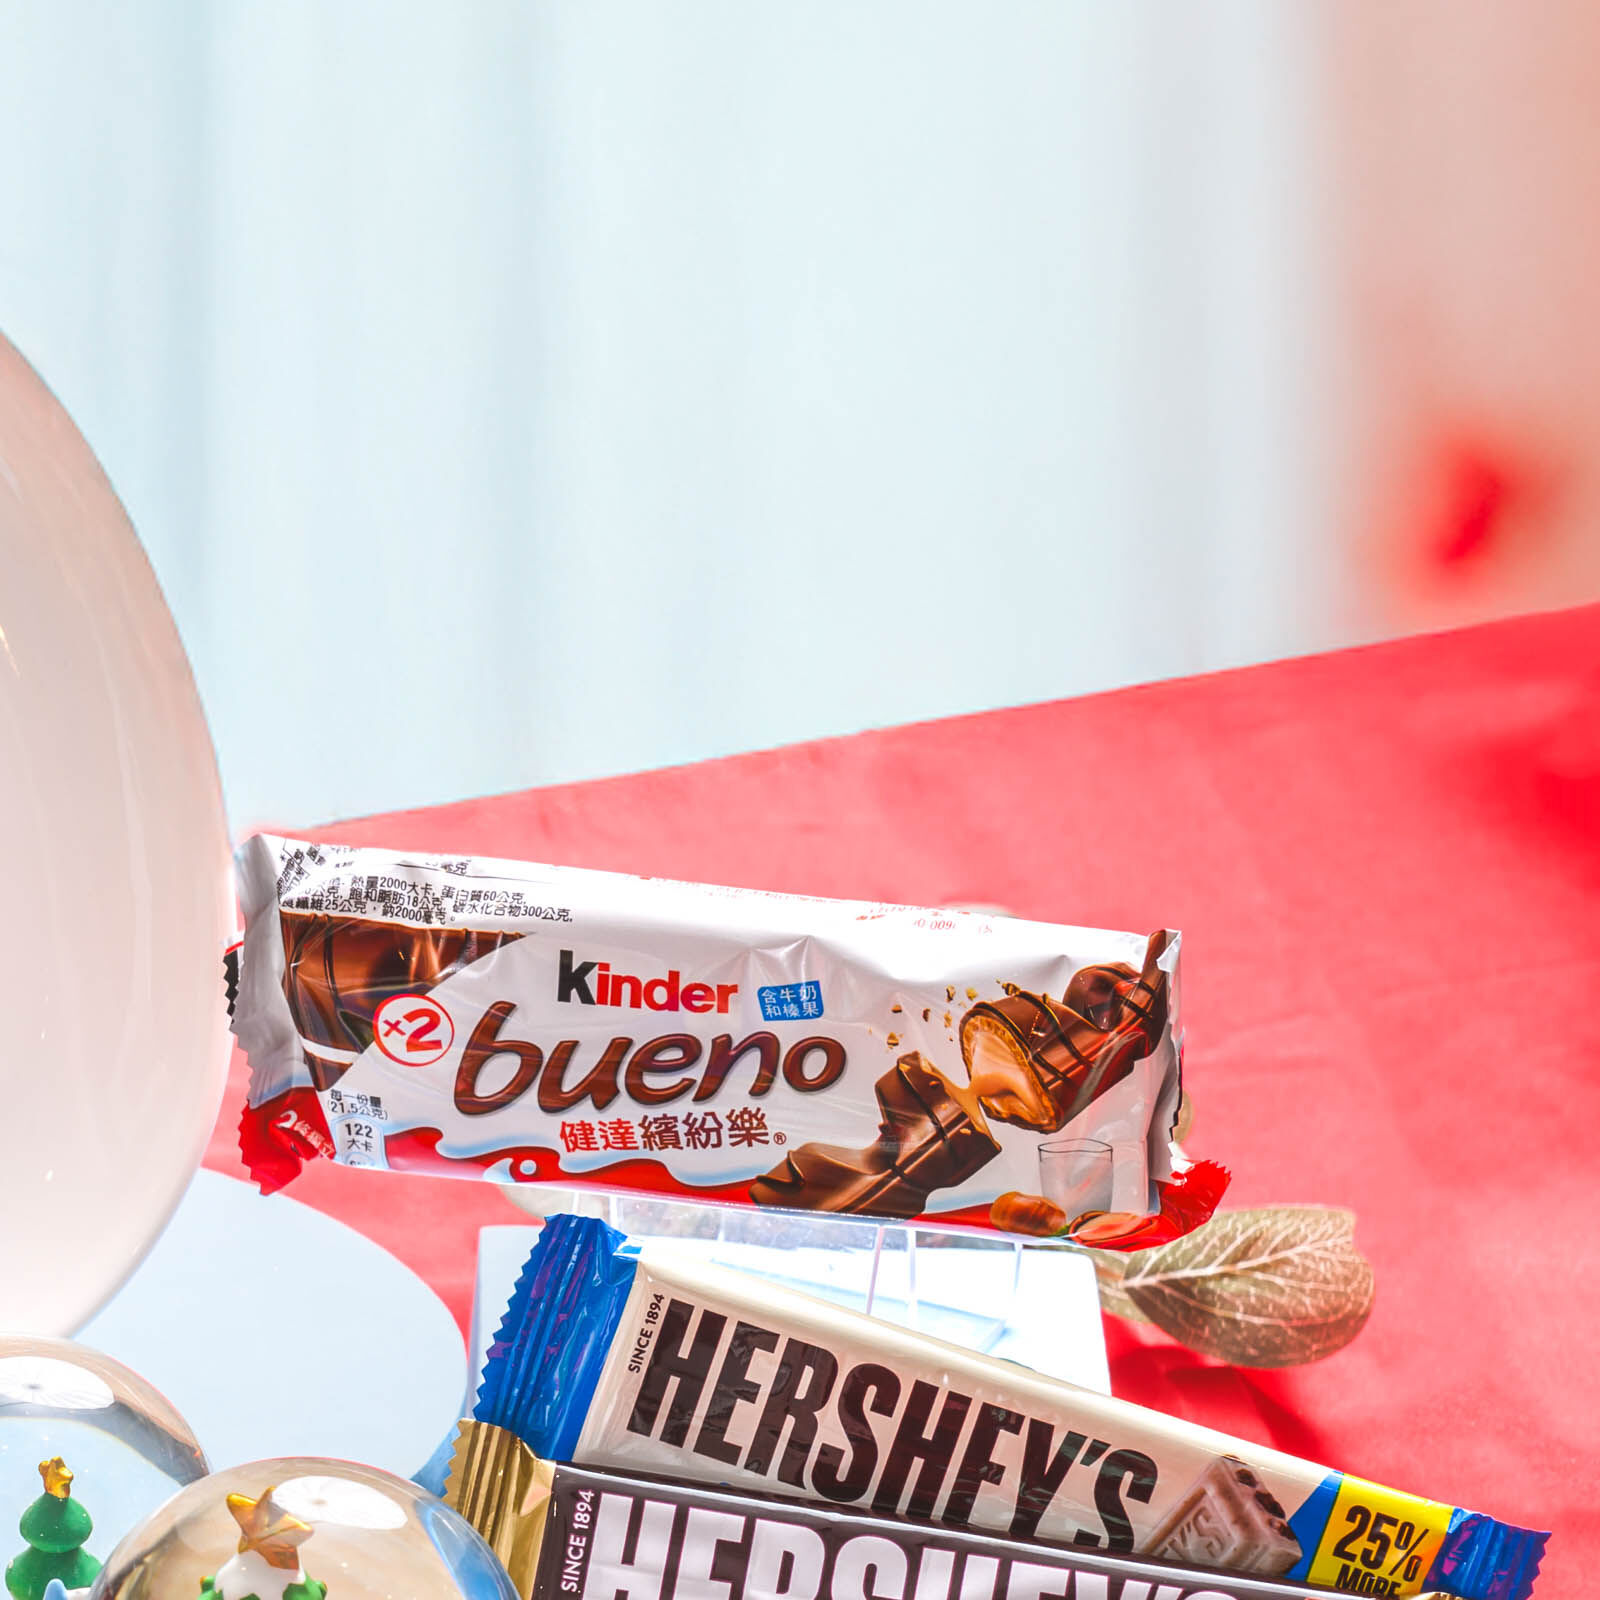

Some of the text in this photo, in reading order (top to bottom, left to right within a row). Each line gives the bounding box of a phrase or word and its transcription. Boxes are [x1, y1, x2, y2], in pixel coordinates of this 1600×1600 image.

[557, 949, 738, 1014] Kinder
[761, 984, 817, 1003] 含牛奶
[453, 1000, 847, 1115] bueno
[345, 1123, 373, 1139] 122
[347, 1139, 373, 1152] 大卡
[628, 1293, 665, 1373] SINCE 1894
[627, 1297, 1159, 1554] HERSHEY'S
[561, 1488, 596, 1592] SINCE 1894
[1333, 1505, 1429, 1583] 25%
